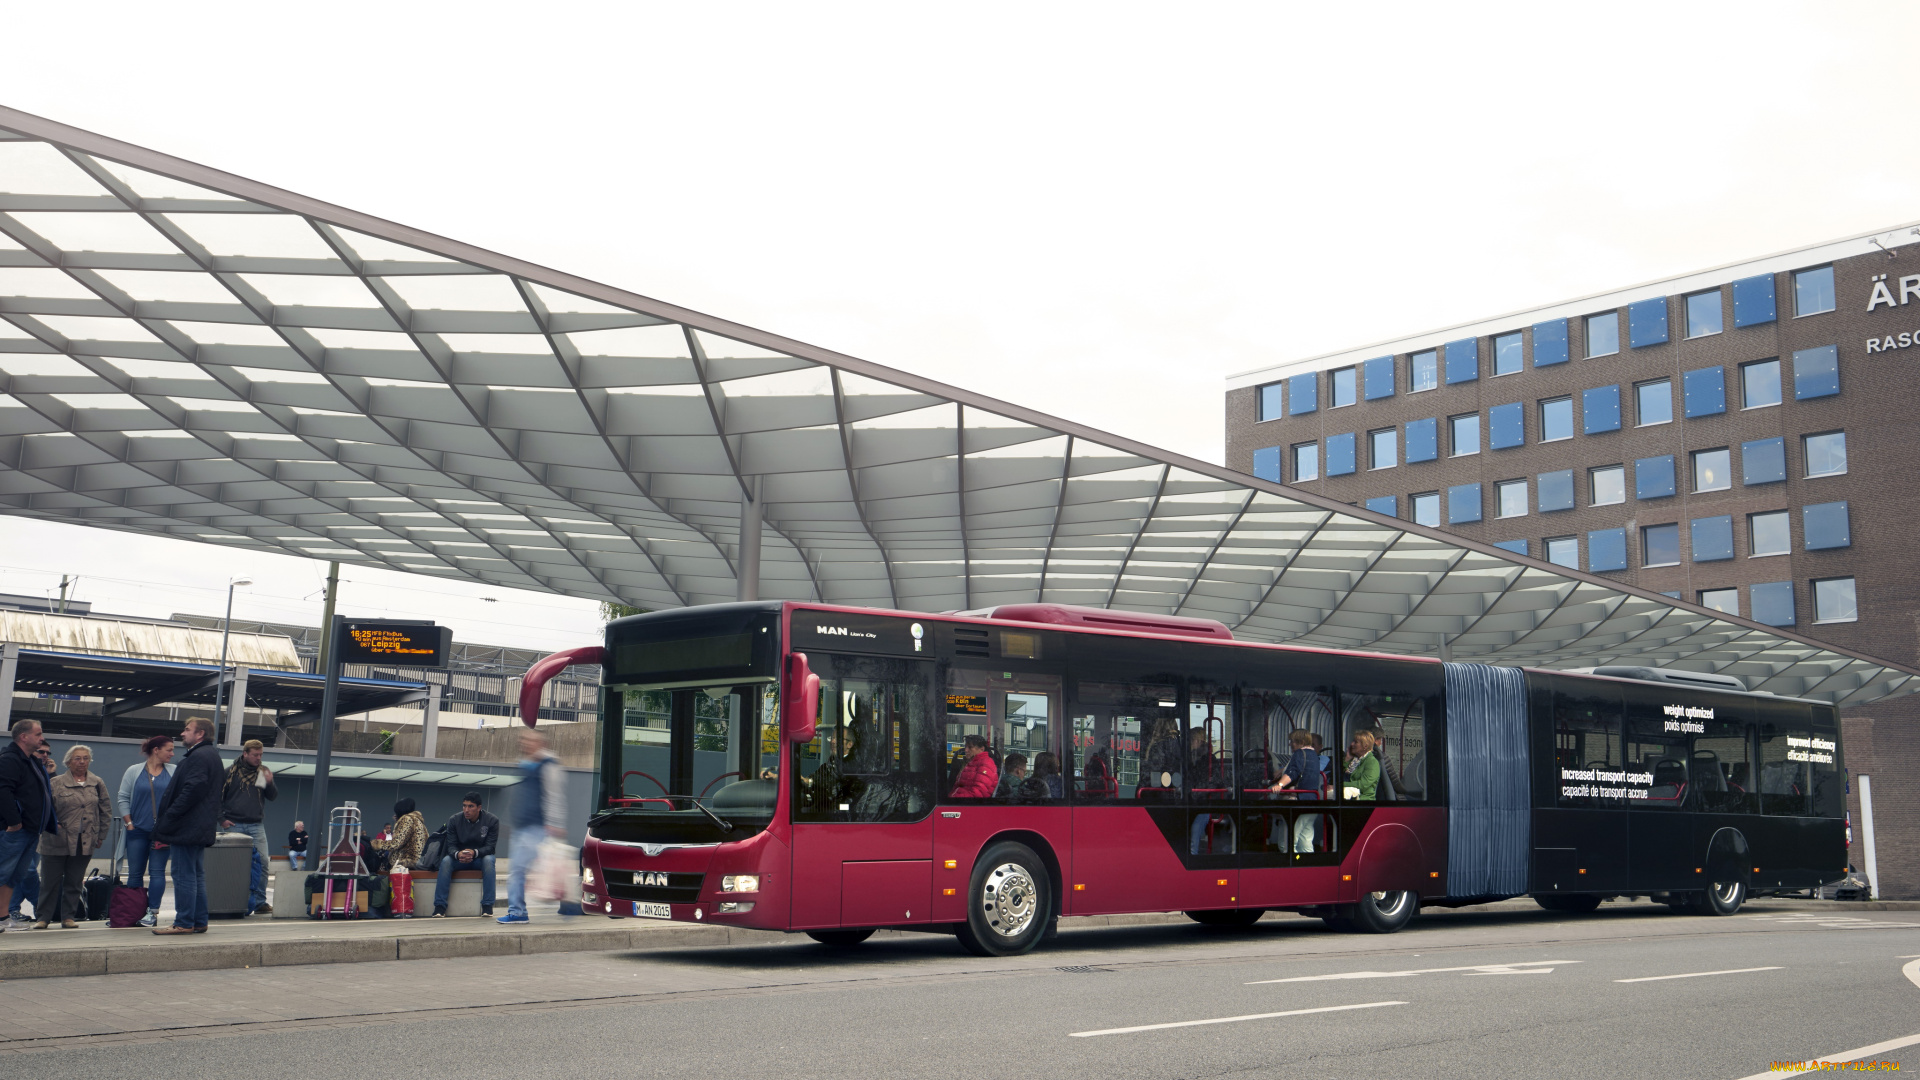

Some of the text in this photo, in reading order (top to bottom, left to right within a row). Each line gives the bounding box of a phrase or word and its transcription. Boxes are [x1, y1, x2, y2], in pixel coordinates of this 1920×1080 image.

[817, 626, 848, 635] MAN
[371, 640, 400, 649] Leipzig
[1663, 704, 1714, 719] weight optimized
[1665, 719, 1704, 734] poids optimisé
[1787, 735, 1835, 752] improved efficiency
[1788, 750, 1809, 761] efficacité
[1562, 767, 1653, 786] increased transport capacity
[1562, 784, 1648, 800] capacité de transport accrue
[633, 872, 668, 886] MAN
[645, 905, 653, 915] AN
[654, 906, 670, 916] 2015
